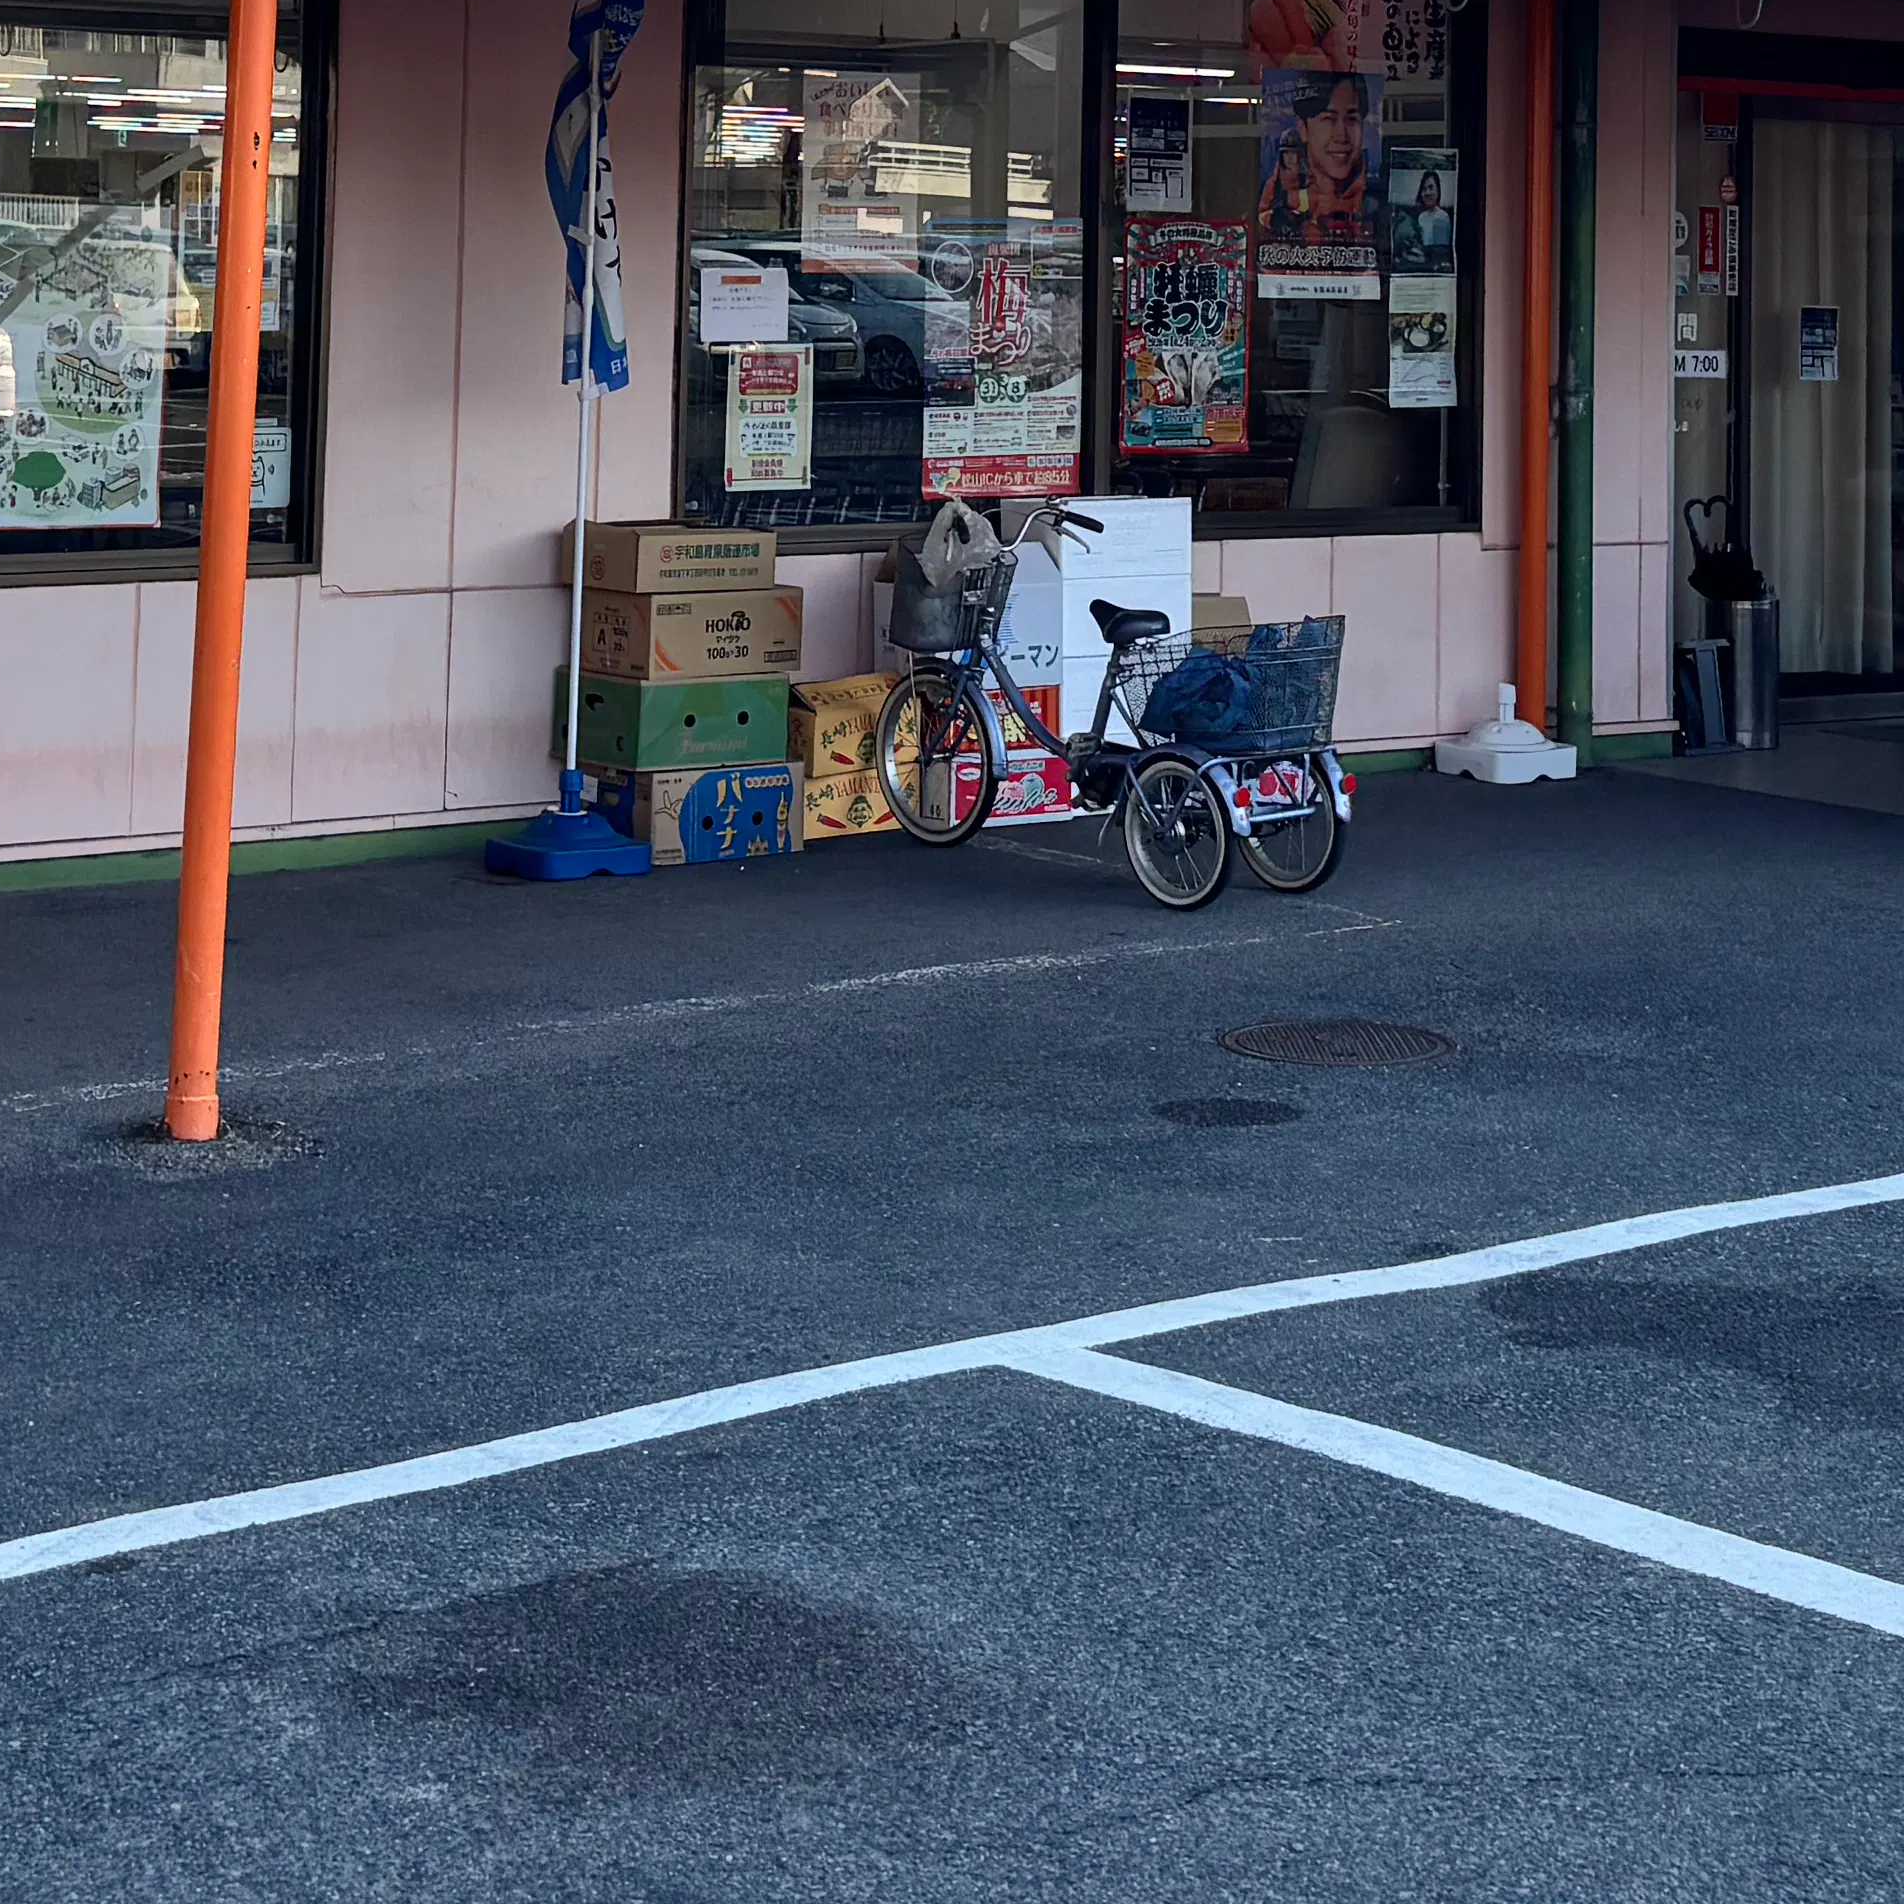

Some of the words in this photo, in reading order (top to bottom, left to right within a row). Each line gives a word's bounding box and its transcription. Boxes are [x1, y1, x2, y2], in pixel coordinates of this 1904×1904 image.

[976, 258, 1032, 332] 梅
[1142, 298, 1229, 337] まつり
[969, 322, 1033, 365] まつり
[1692, 355, 1719, 373] 7:00
[597, 629, 607, 646] A
[998, 644, 1059, 669] ーマン
[715, 772, 744, 850] バナナ
